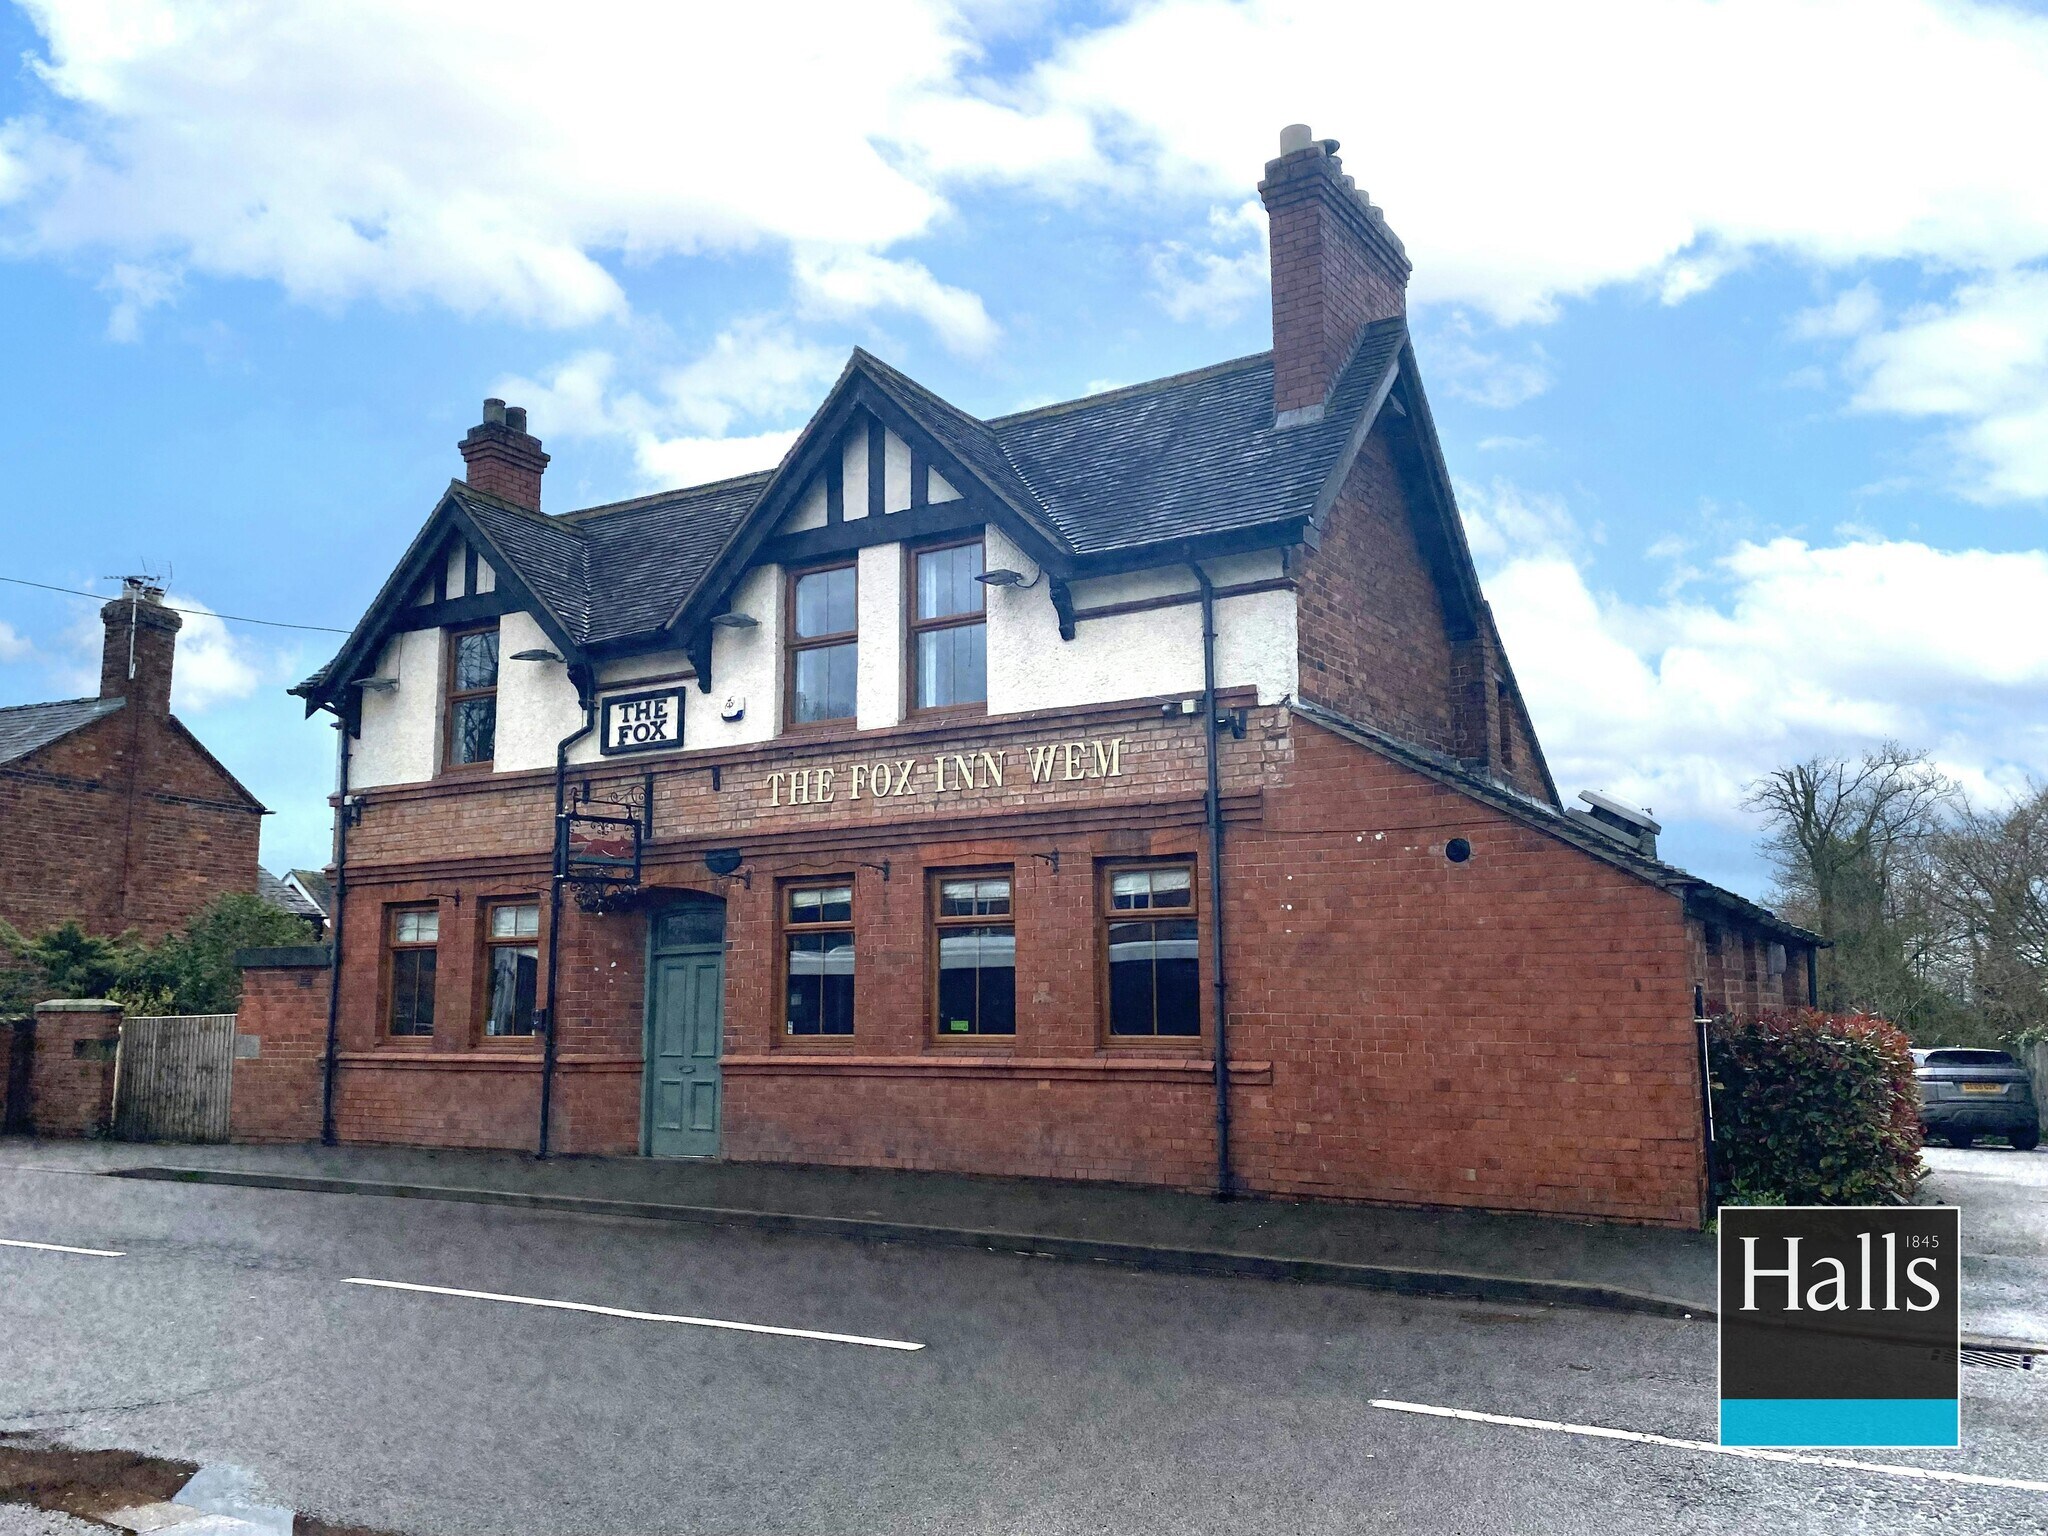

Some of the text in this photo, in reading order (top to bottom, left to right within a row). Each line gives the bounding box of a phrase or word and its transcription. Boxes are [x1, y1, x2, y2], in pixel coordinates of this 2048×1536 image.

[618, 699, 668, 723] THE
[617, 720, 667, 745] FOX
[766, 738, 1124, 807] THE FOX INN WEM
